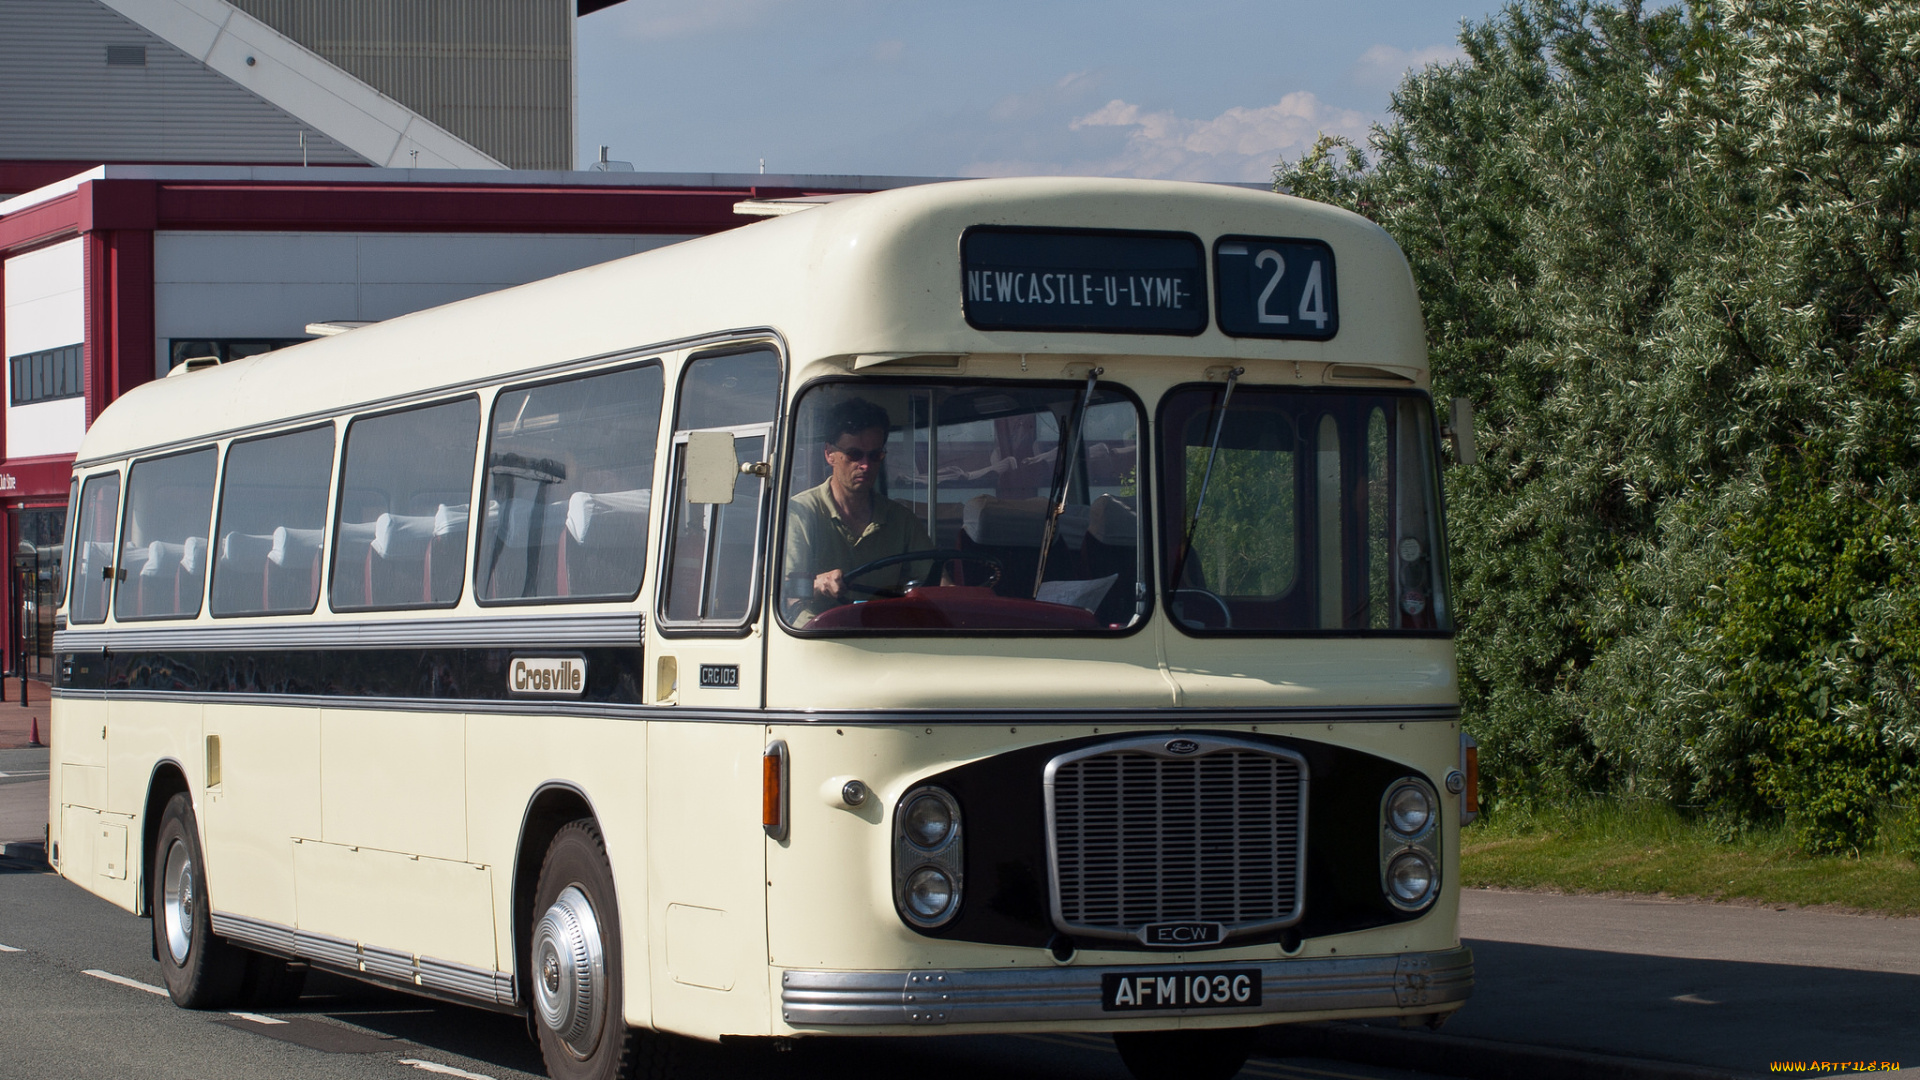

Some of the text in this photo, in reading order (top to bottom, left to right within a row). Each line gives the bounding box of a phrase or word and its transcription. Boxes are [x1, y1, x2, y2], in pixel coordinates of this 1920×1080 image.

[1254, 249, 1329, 329] 24
[515, 660, 581, 691] Crosville
[701, 667, 736, 685] CRG103
[1157, 926, 1208, 941] ECW
[1115, 974, 1251, 1006] AFM 103G
